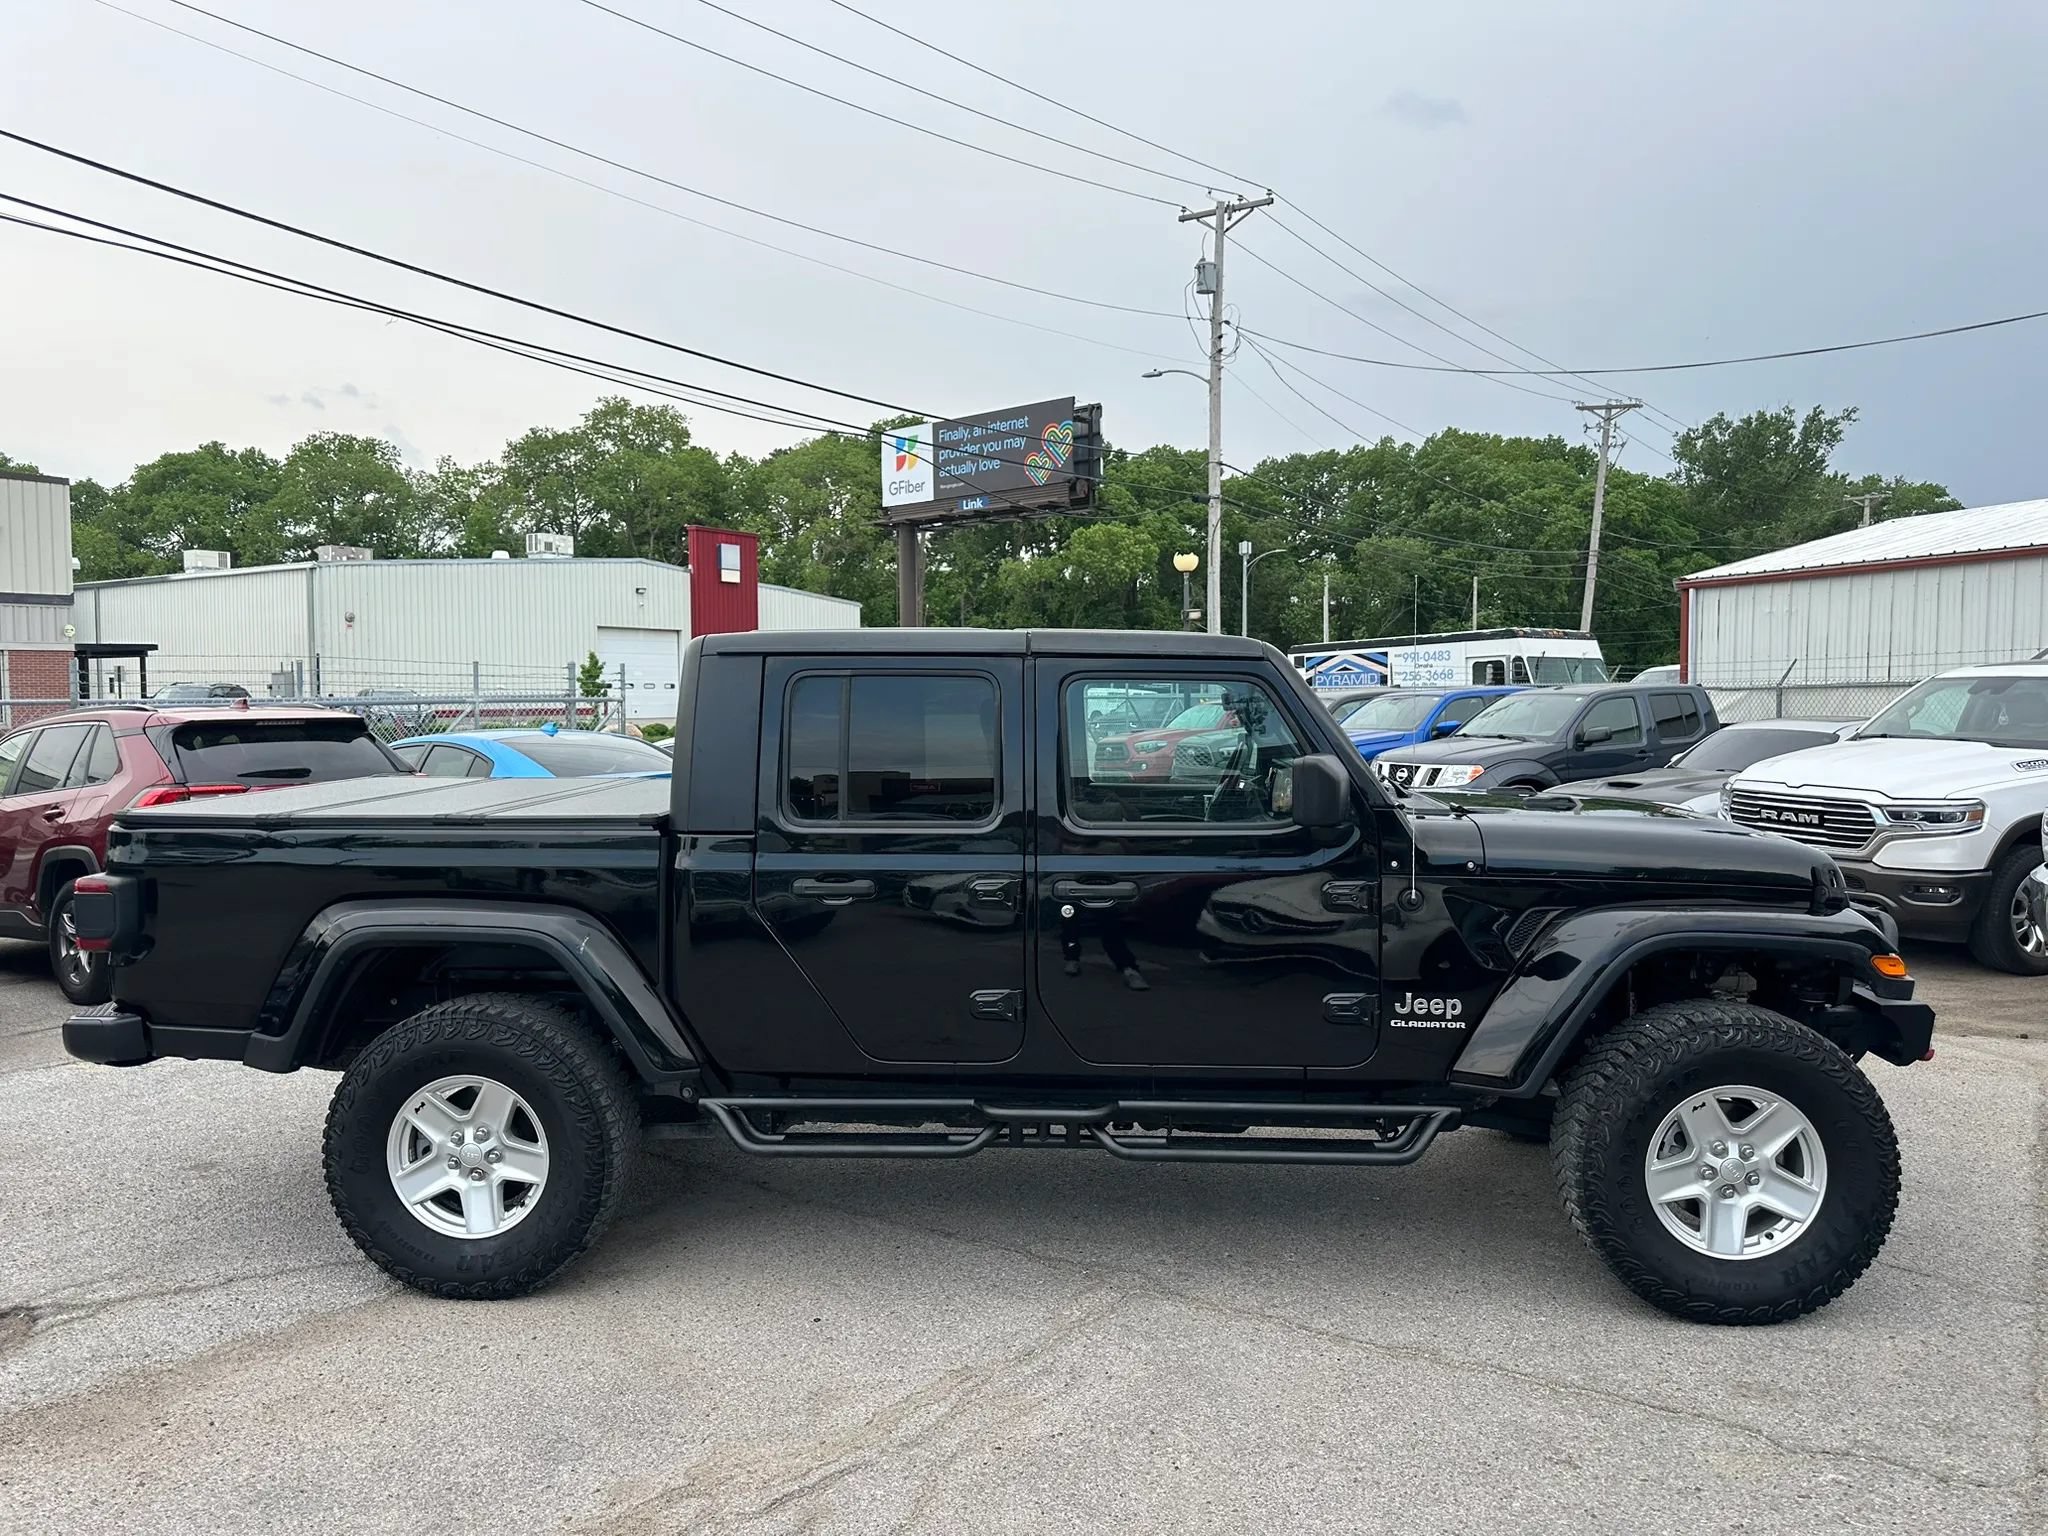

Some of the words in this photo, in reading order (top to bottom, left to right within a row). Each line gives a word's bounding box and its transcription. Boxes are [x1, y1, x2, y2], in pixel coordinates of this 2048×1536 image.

[939, 425, 971, 442] Finally,
[973, 424, 987, 437] an
[988, 416, 1029, 434] internet
[939, 439, 980, 463] provider
[982, 439, 1001, 456] you
[1003, 436, 1027, 453] may
[939, 460, 977, 478] actually
[979, 457, 1000, 471] love
[889, 480, 926, 496] GFiber
[963, 497, 984, 510] Link
[1402, 650, 1451, 663] 991-0483
[1315, 673, 1378, 687] PYRAMID
[1402, 669, 1454, 682] 256-3668
[1760, 808, 1819, 825] RAM
[1394, 992, 1462, 1020] Jeep
[1390, 1019, 1466, 1029] GLADIATOR
